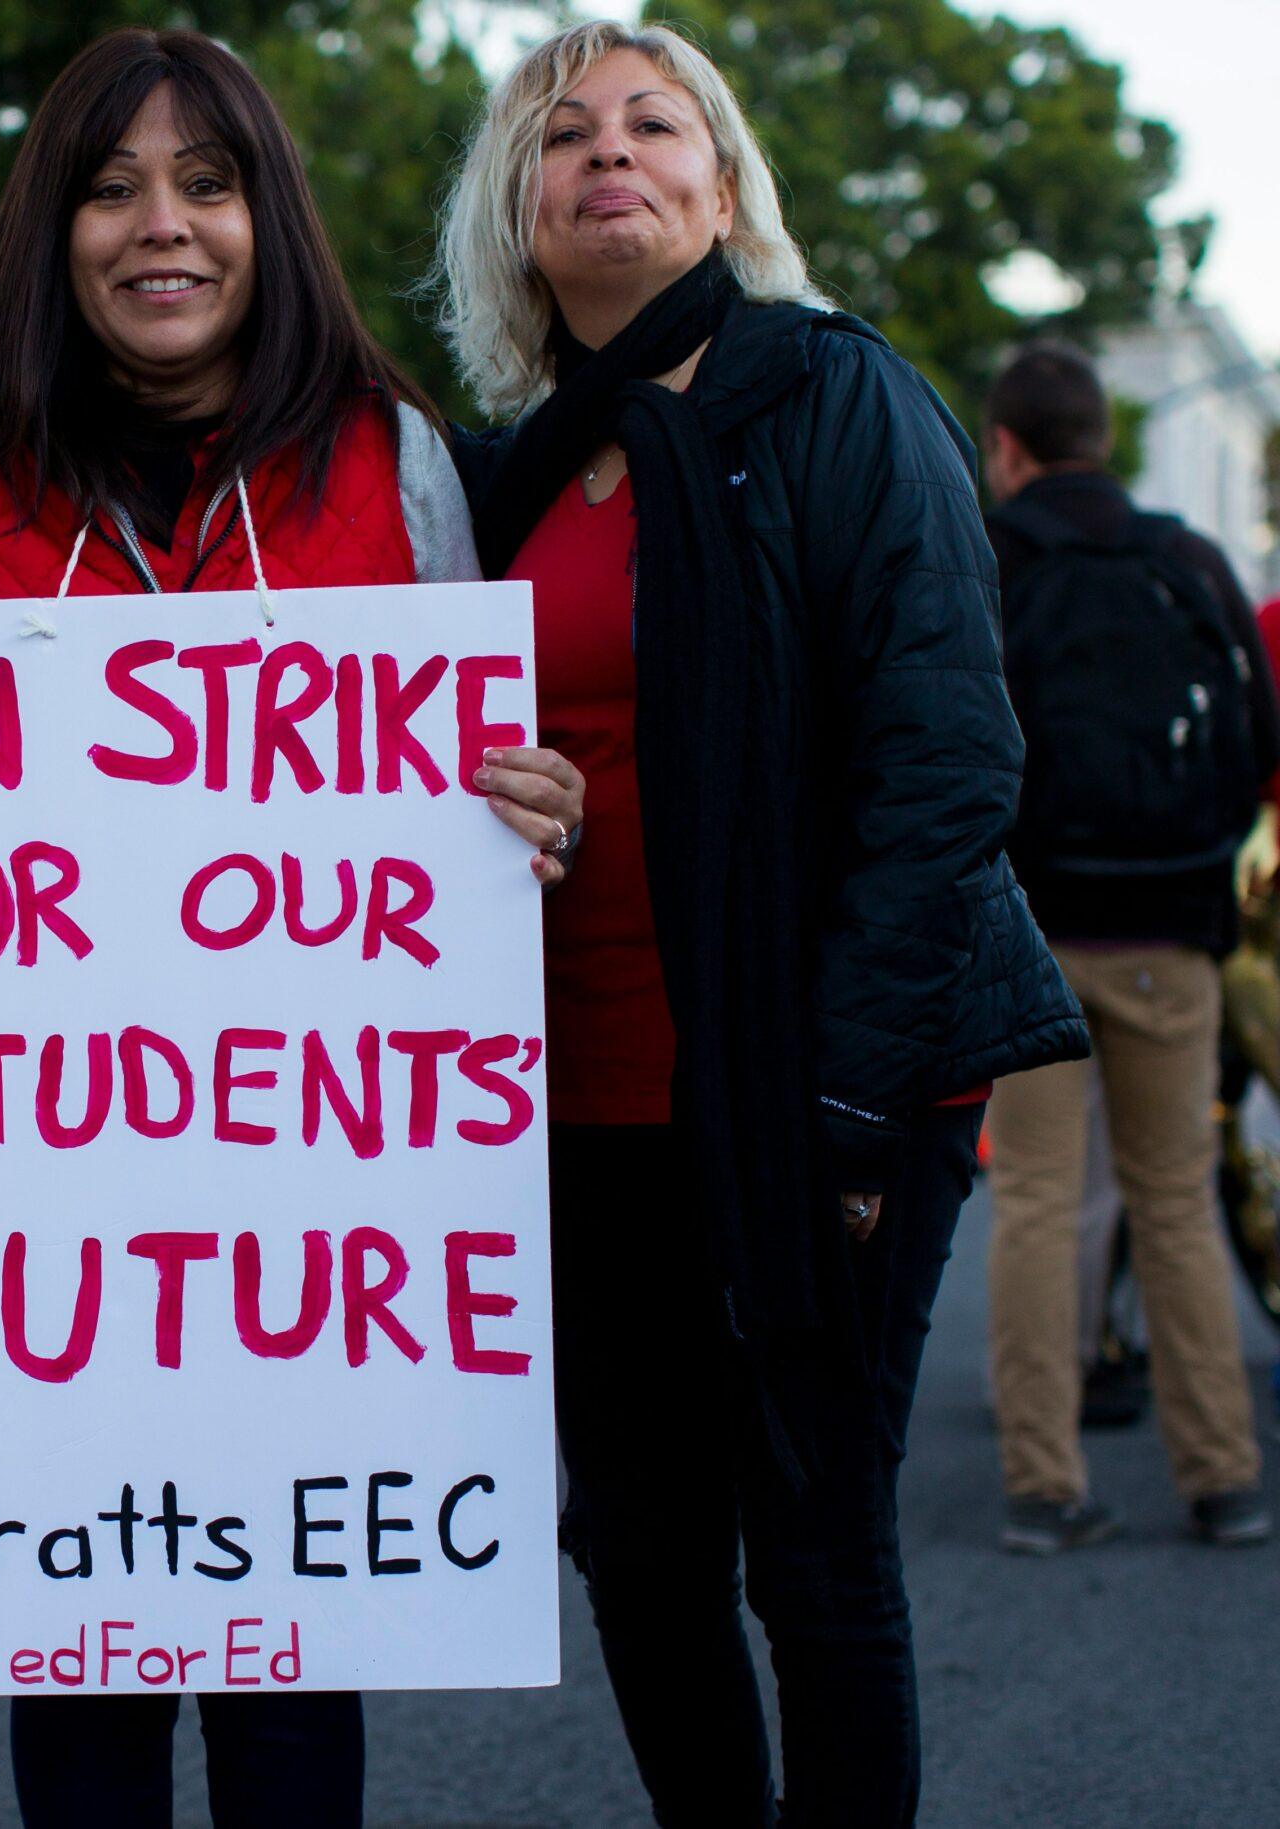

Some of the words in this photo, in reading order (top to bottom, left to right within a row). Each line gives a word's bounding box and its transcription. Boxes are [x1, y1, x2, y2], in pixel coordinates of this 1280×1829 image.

[87, 638, 527, 804] STRIKE
[180, 852, 441, 970] OUR
[819, 1095, 887, 1123] OMNI-HEAT
[292, 1470, 500, 1578] EEC
